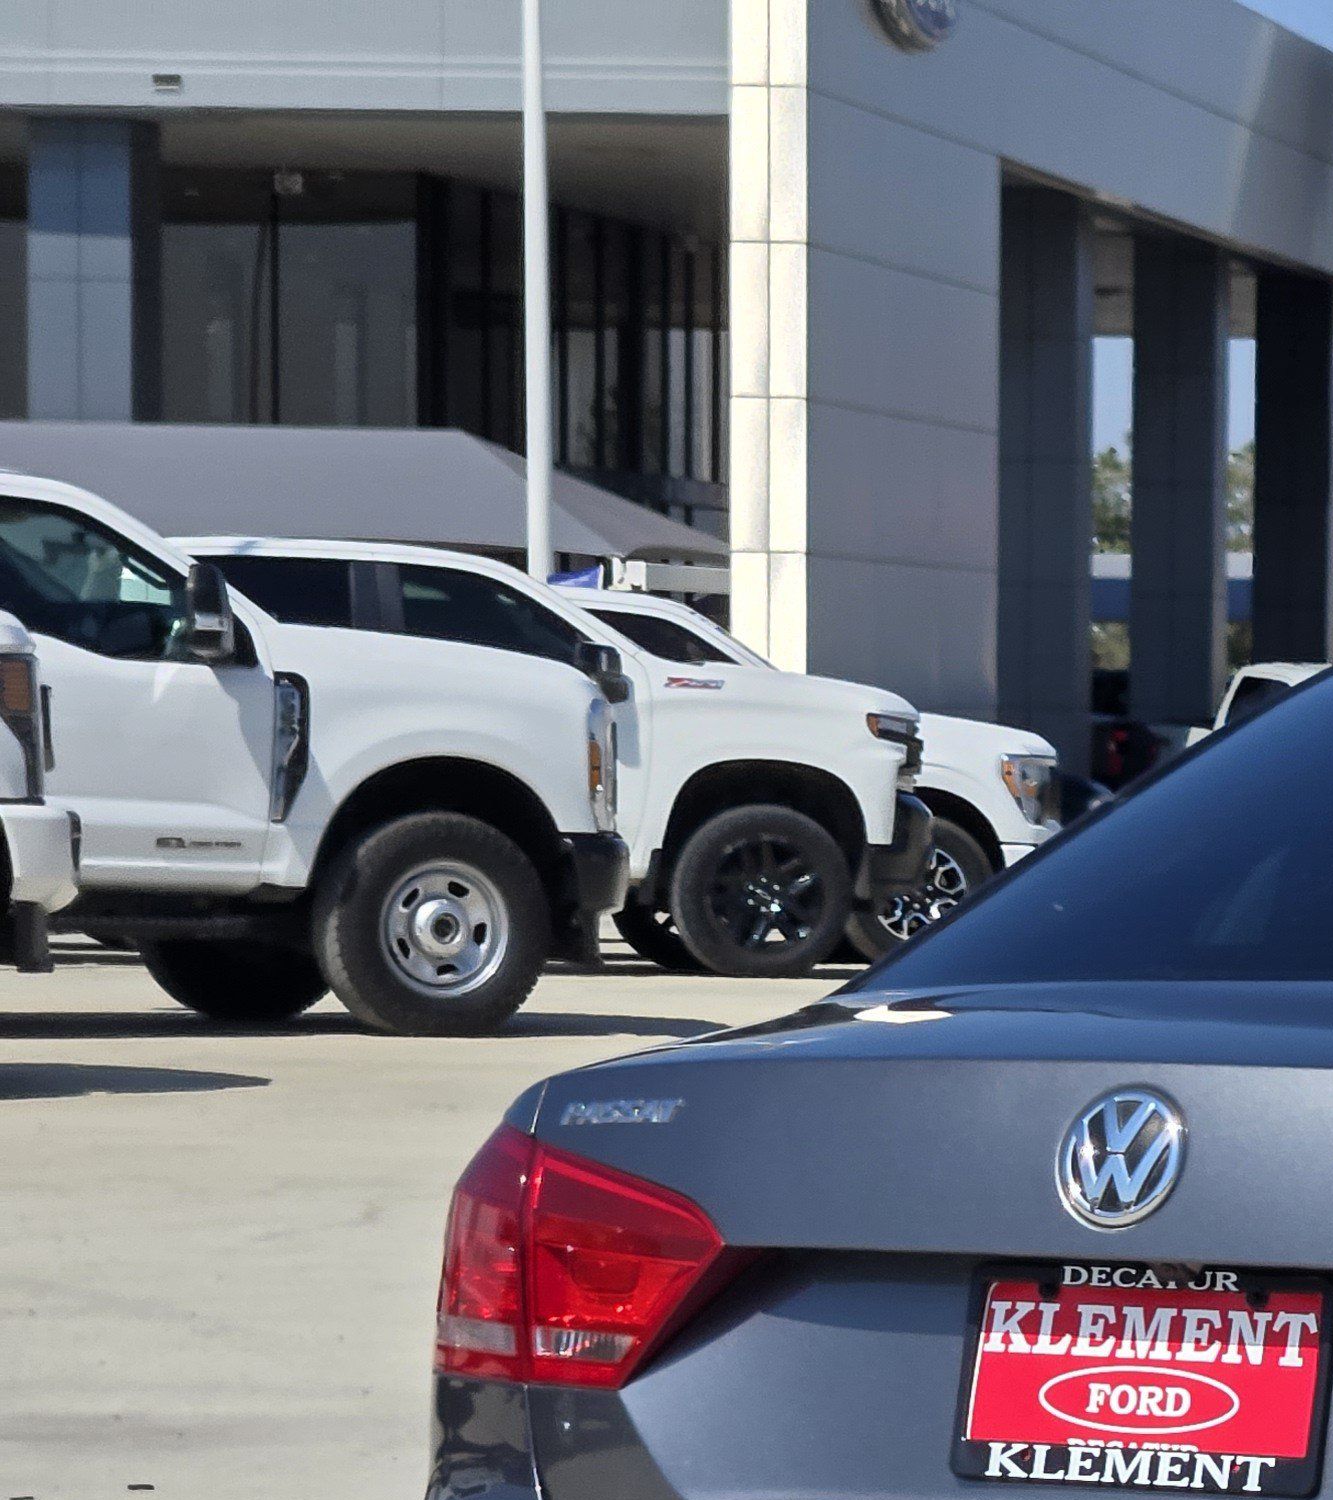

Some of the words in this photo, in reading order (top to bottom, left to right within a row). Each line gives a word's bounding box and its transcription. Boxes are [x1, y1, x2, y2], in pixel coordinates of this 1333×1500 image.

[1062, 1265, 1239, 1292] DECAUR
[983, 1300, 1319, 1368] KLEMENT
[1085, 1382, 1191, 1418] FORD
[985, 1441, 1276, 1492] KLEMENT
